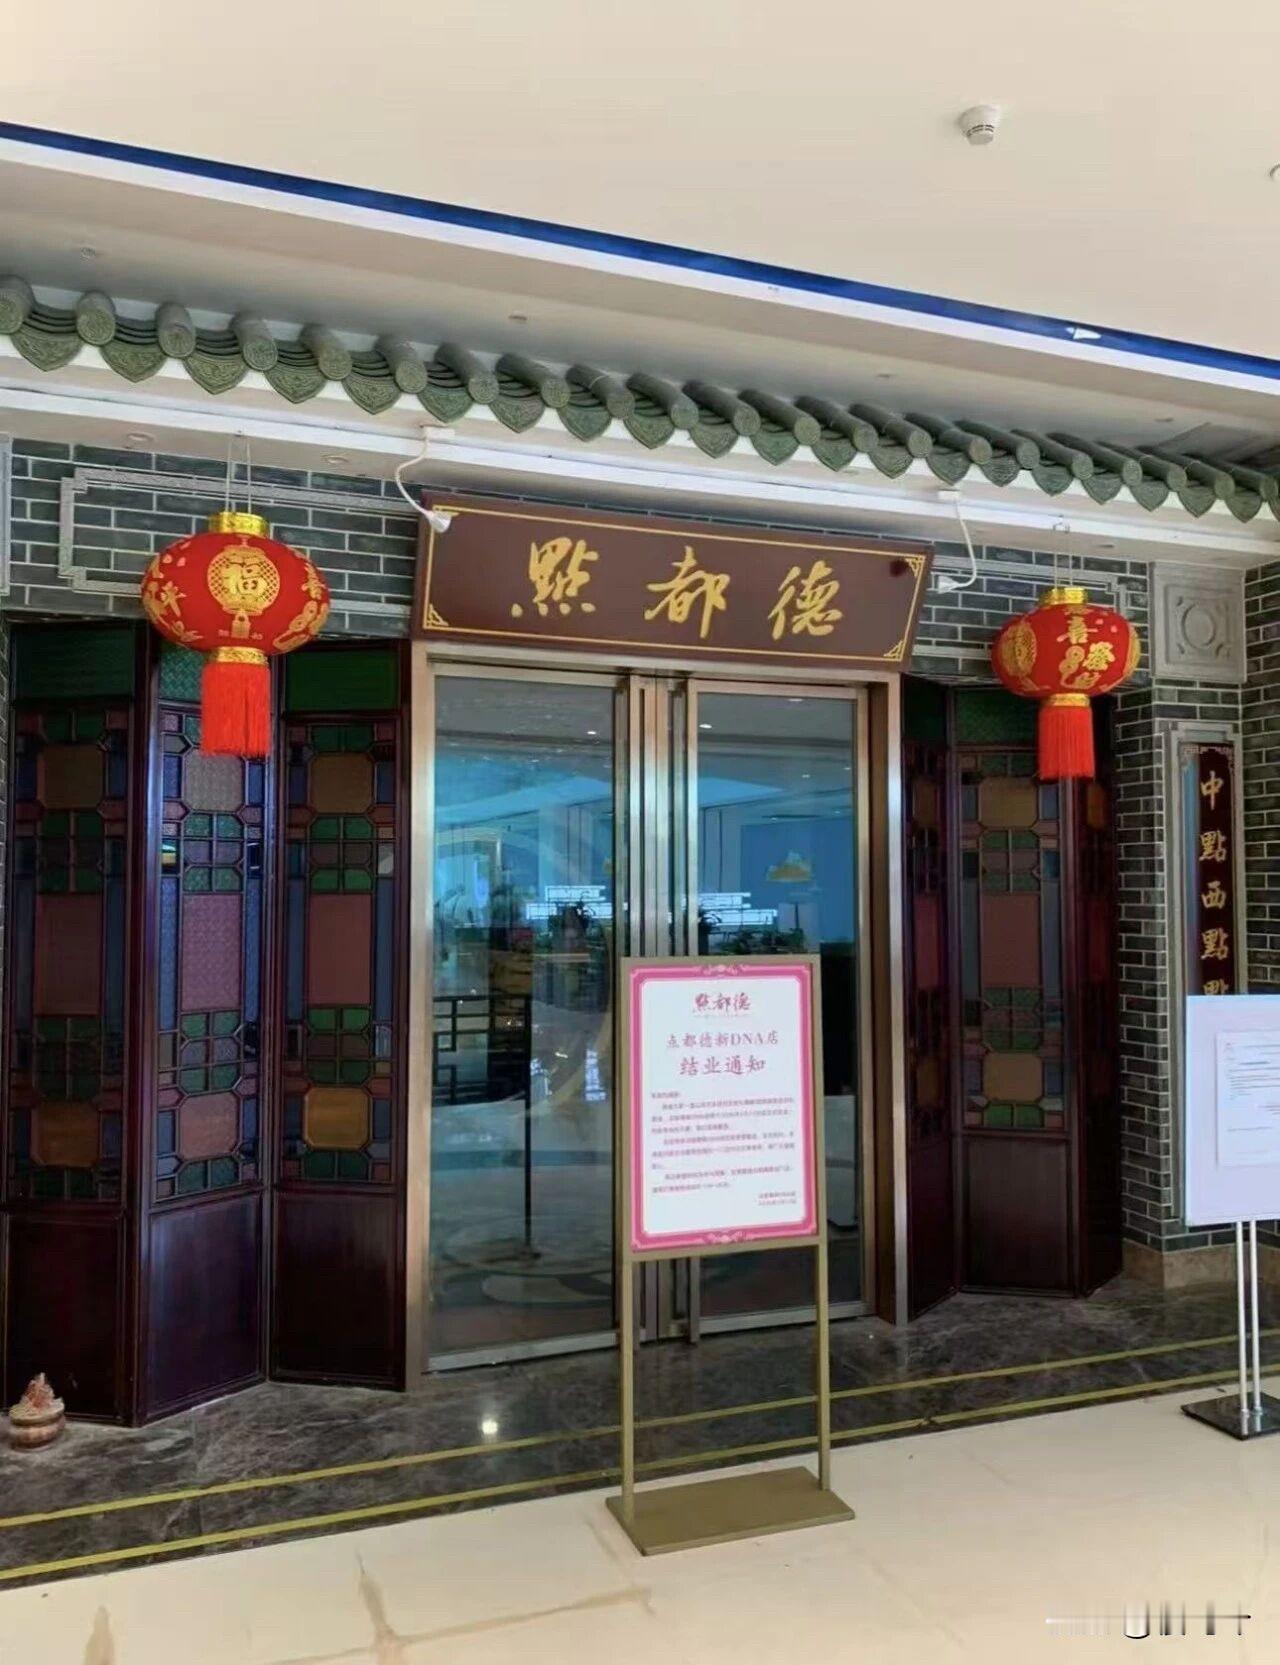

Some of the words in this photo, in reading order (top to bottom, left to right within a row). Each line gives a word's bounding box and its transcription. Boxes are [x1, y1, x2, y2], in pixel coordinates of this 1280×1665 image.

[511, 536, 843, 641] 點都德
[666, 1030, 780, 1049] 点都德新DNA店
[679, 1055, 767, 1077] 结业通知
